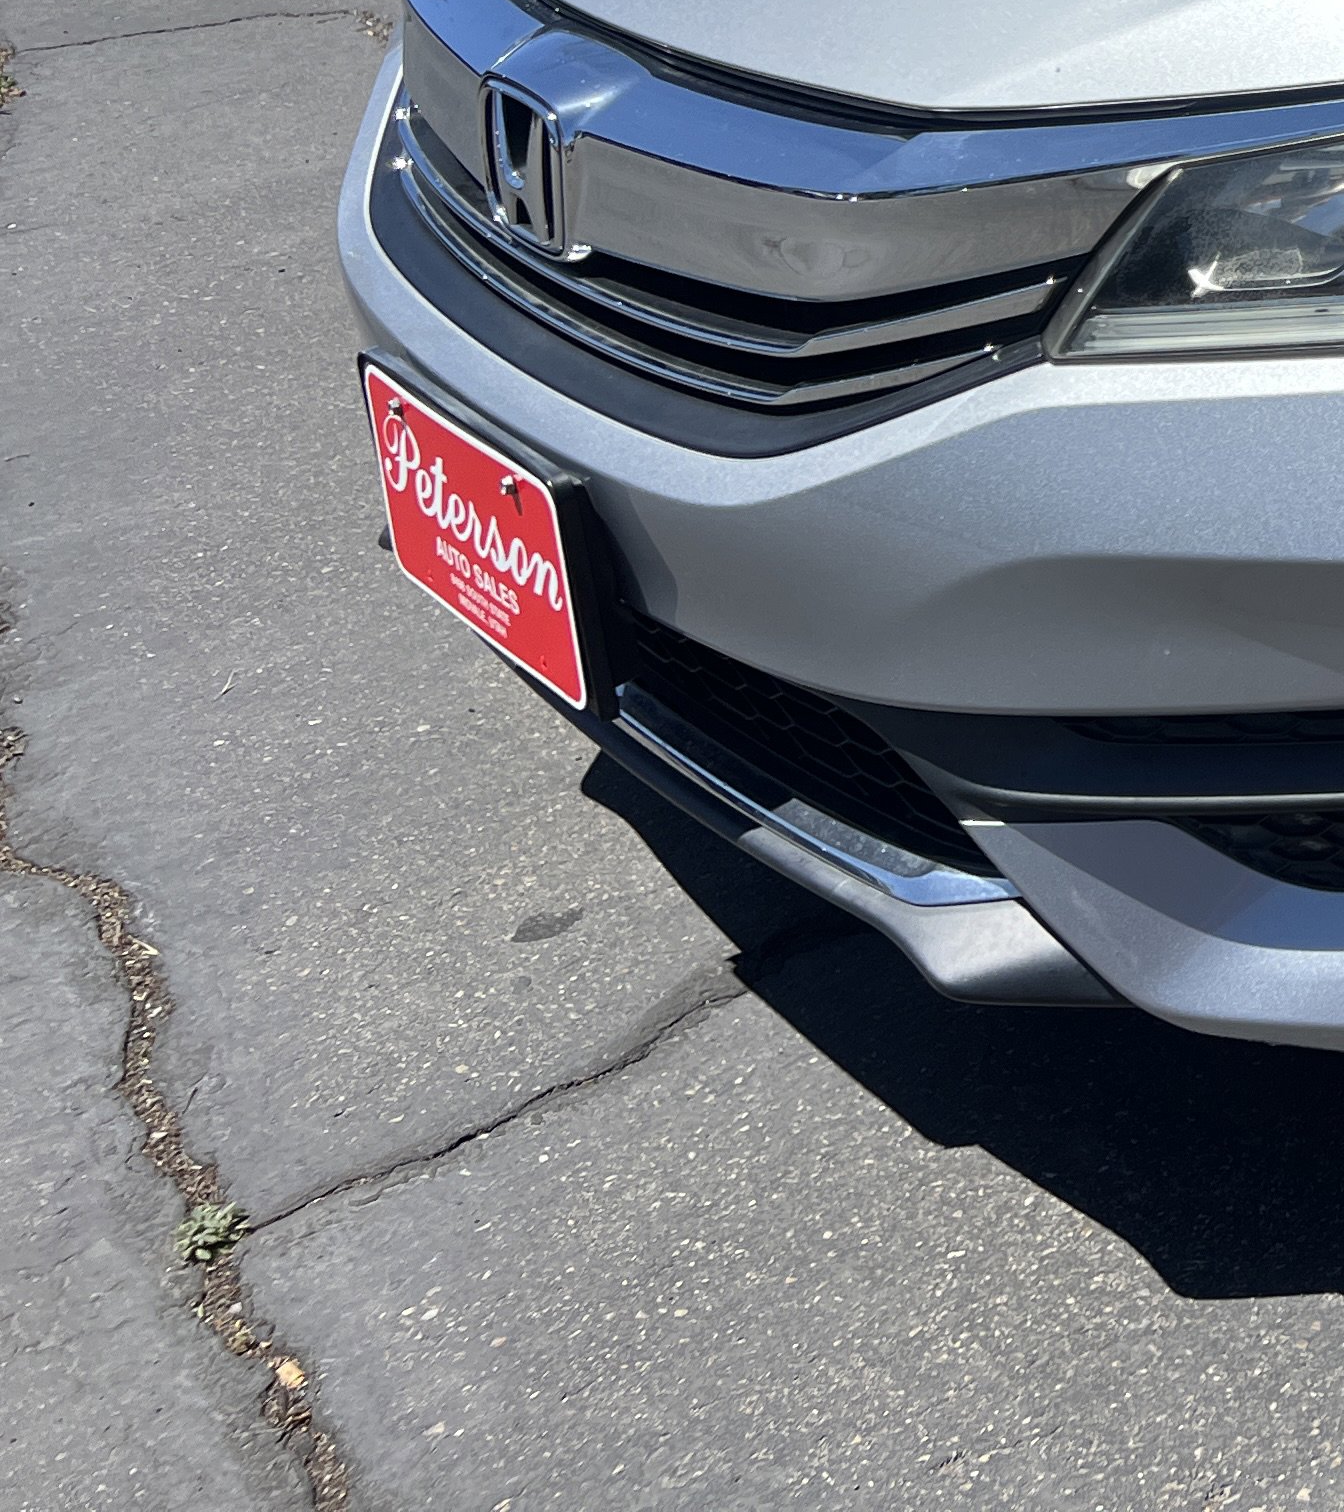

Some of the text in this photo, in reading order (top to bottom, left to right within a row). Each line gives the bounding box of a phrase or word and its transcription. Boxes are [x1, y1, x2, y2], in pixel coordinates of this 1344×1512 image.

[382, 414, 563, 612] Peterson
[436, 536, 471, 579] AUTO
[473, 564, 520, 616] SALES
